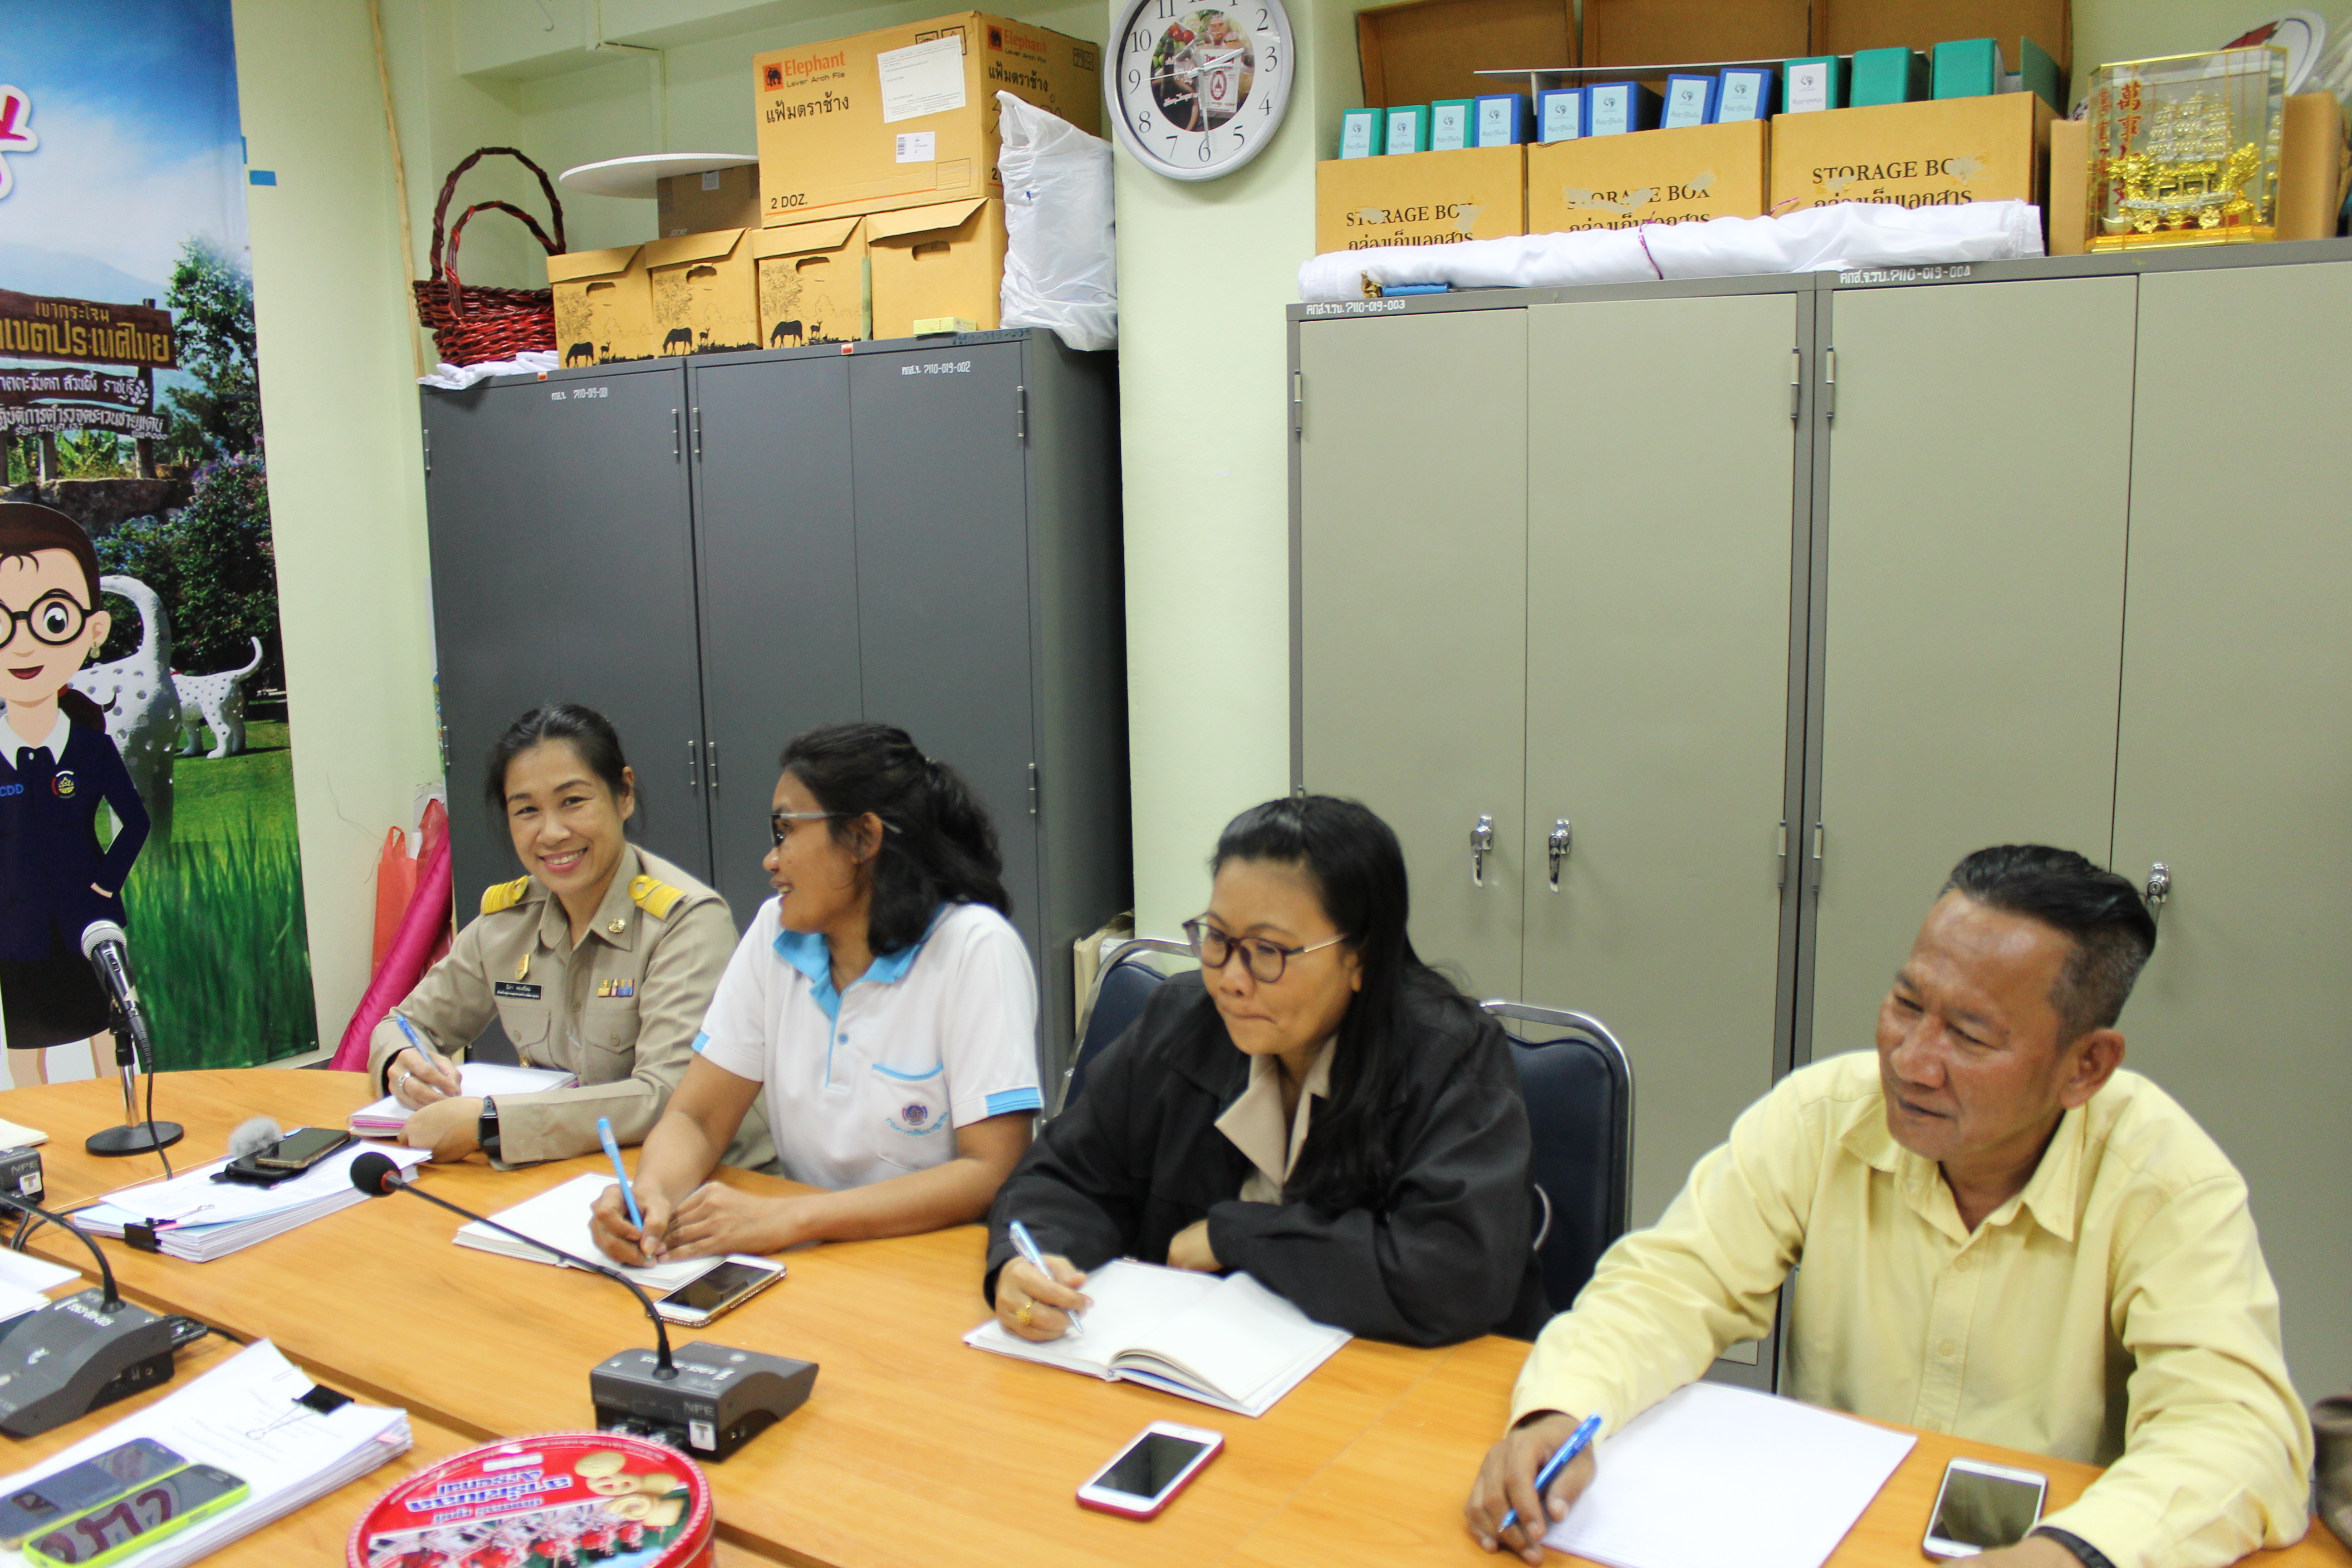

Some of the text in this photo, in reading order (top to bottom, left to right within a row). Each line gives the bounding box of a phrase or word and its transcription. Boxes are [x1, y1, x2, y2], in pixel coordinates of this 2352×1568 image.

[1256, 9, 1268, 31] 2
[1131, 29, 1152, 53] 10
[784, 51, 846, 77] Elephant
[1265, 46, 1278, 72] 3
[787, 79, 808, 88] Lever
[811, 74, 830, 83] Arch
[1128, 69, 1141, 94] 9
[766, 90, 849, 123] แฟ้มตราช้าง
[1259, 91, 1272, 116] 4
[1139, 111, 1152, 133] 8
[1166, 135, 1178, 158] 7
[1198, 137, 1210, 162] 6
[1233, 125, 1245, 151] 5
[1926, 158, 1959, 176] BO
[771, 193, 808, 209] 2 DOZ.
[1347, 203, 1473, 226] STRAGE BO
[35, 301, 110, 323] เขากระโจม
[924, 361, 970, 374] 7110-019-002
[0, 784, 24, 797] CDD
[24, 1175, 36, 1188] T
[694, 1424, 708, 1441] T
[438, 1471, 541, 1497] Arsenal
